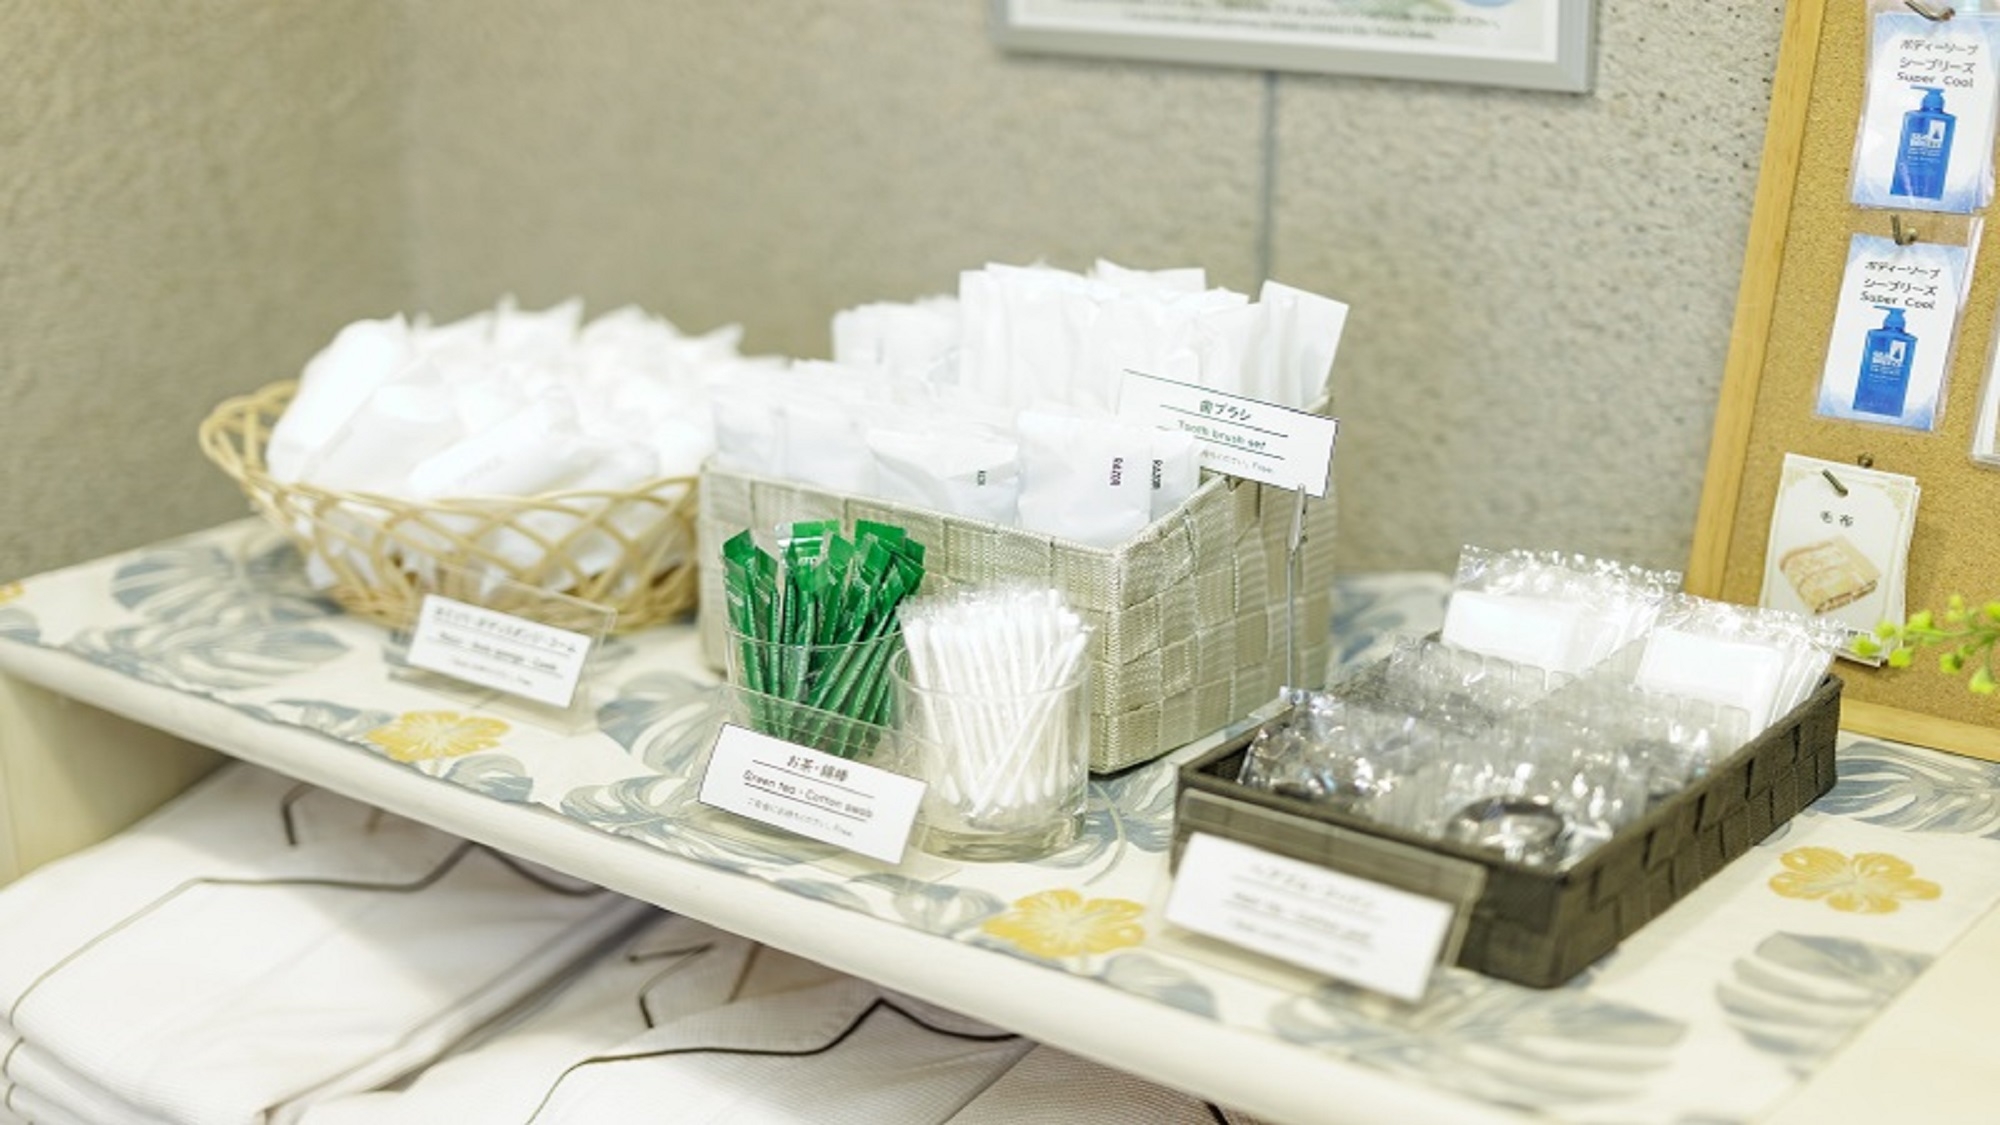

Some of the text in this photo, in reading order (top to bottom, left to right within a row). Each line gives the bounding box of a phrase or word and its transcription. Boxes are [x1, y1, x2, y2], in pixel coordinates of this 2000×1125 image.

[1896, 71, 1974, 89] Super Cool
[1859, 290, 1898, 304] Super
[742, 769, 776, 788] Green
[779, 781, 796, 795] tea
[804, 788, 843, 808] Cotton
